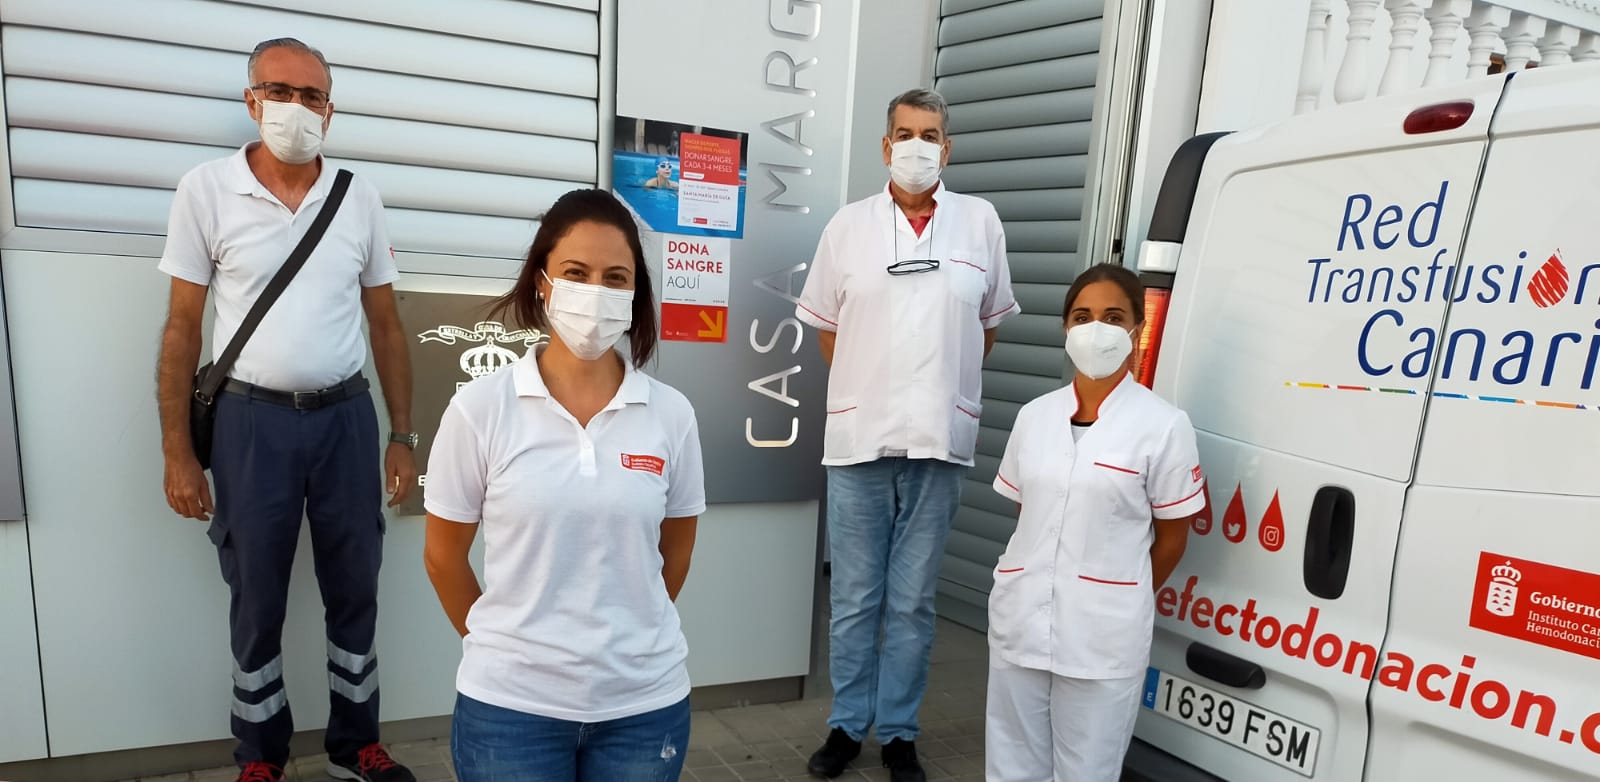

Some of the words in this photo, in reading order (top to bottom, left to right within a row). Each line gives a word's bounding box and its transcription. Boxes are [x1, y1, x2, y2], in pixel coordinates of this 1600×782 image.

[684, 151, 707, 161] DONAR
[684, 160, 701, 169] CADA
[713, 164, 733, 173] MESES
[1337, 181, 1449, 251] Red
[668, 241, 710, 256] DONA
[667, 257, 723, 274] SANGRE
[666, 274, 701, 289] AQUÍ
[745, 262, 807, 448] CASA
[1528, 610, 1579, 631] Instituto
[1147, 693, 1153, 702] E
[1165, 678, 1235, 735] 1639
[1242, 709, 1311, 768] FSM
